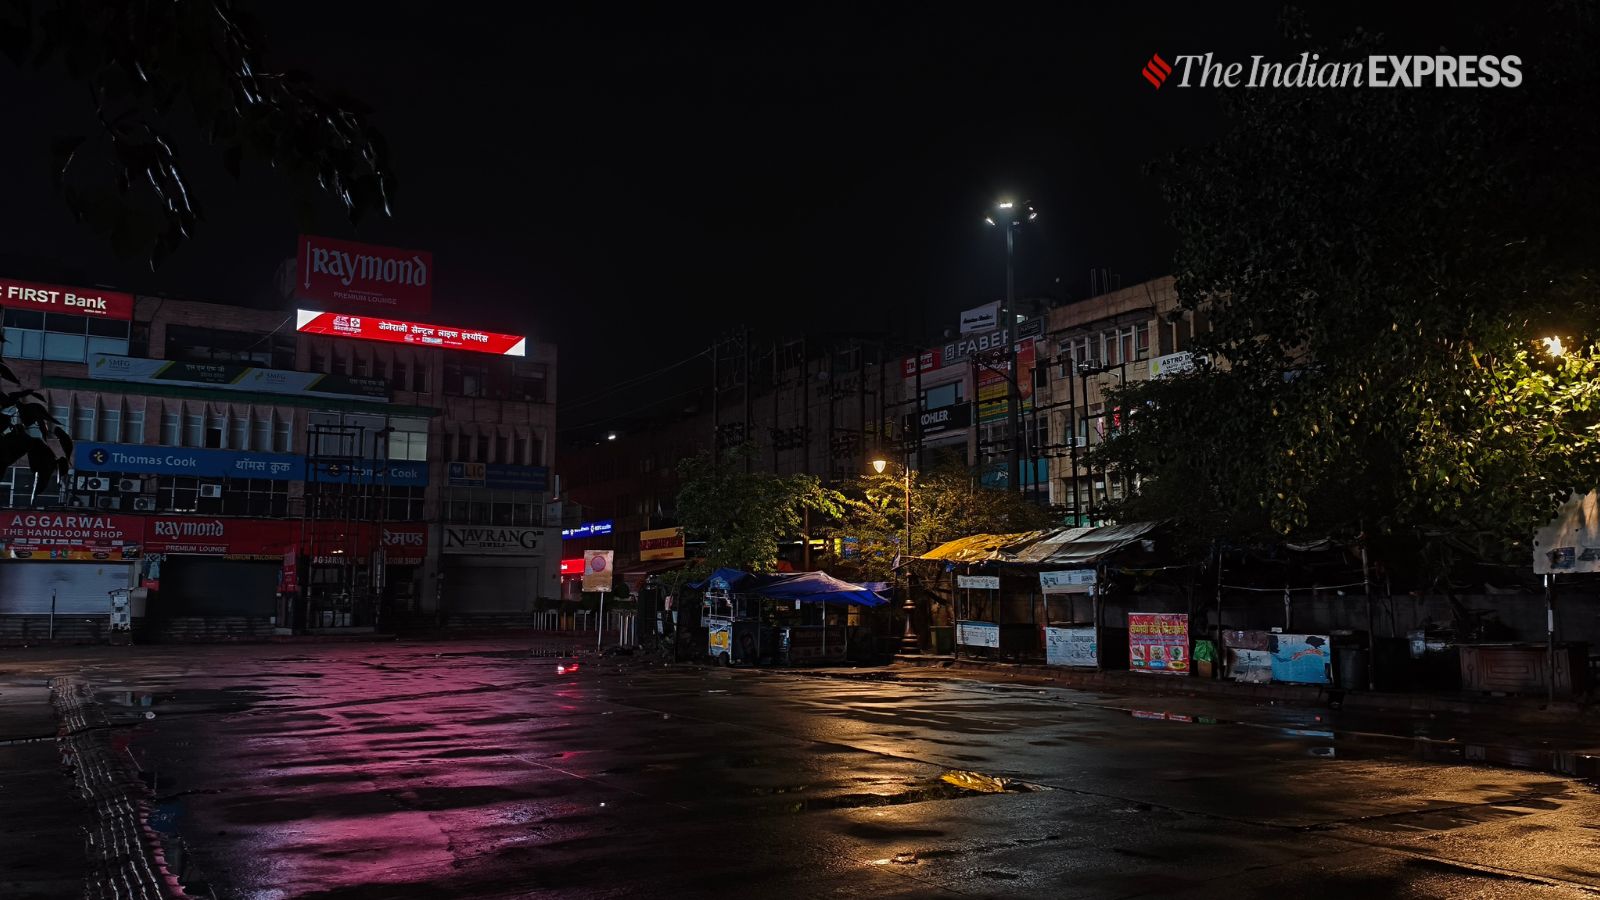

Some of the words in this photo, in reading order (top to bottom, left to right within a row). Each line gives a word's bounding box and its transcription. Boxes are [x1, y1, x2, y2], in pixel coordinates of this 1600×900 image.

[312, 247, 427, 287] Raymond
[7, 285, 60, 304] FIRST
[64, 292, 107, 310] Bank
[333, 290, 367, 302] PREMIUM
[112, 452, 162, 466] Thomas
[165, 455, 197, 468] Cook
[270, 461, 293, 475] कुक
[391, 467, 418, 479] Cook
[465, 464, 484, 480] LIC
[11, 514, 116, 529] AGGARWAL
[3, 528, 24, 536] THE
[27, 529, 90, 538] HANDLOOM
[93, 530, 123, 539] SHOP
[154, 520, 224, 540] Raymond
[445, 528, 537, 549] NAVRANG
[165, 544, 197, 552] PREMIUM
[199, 544, 228, 553] LOUNGE
